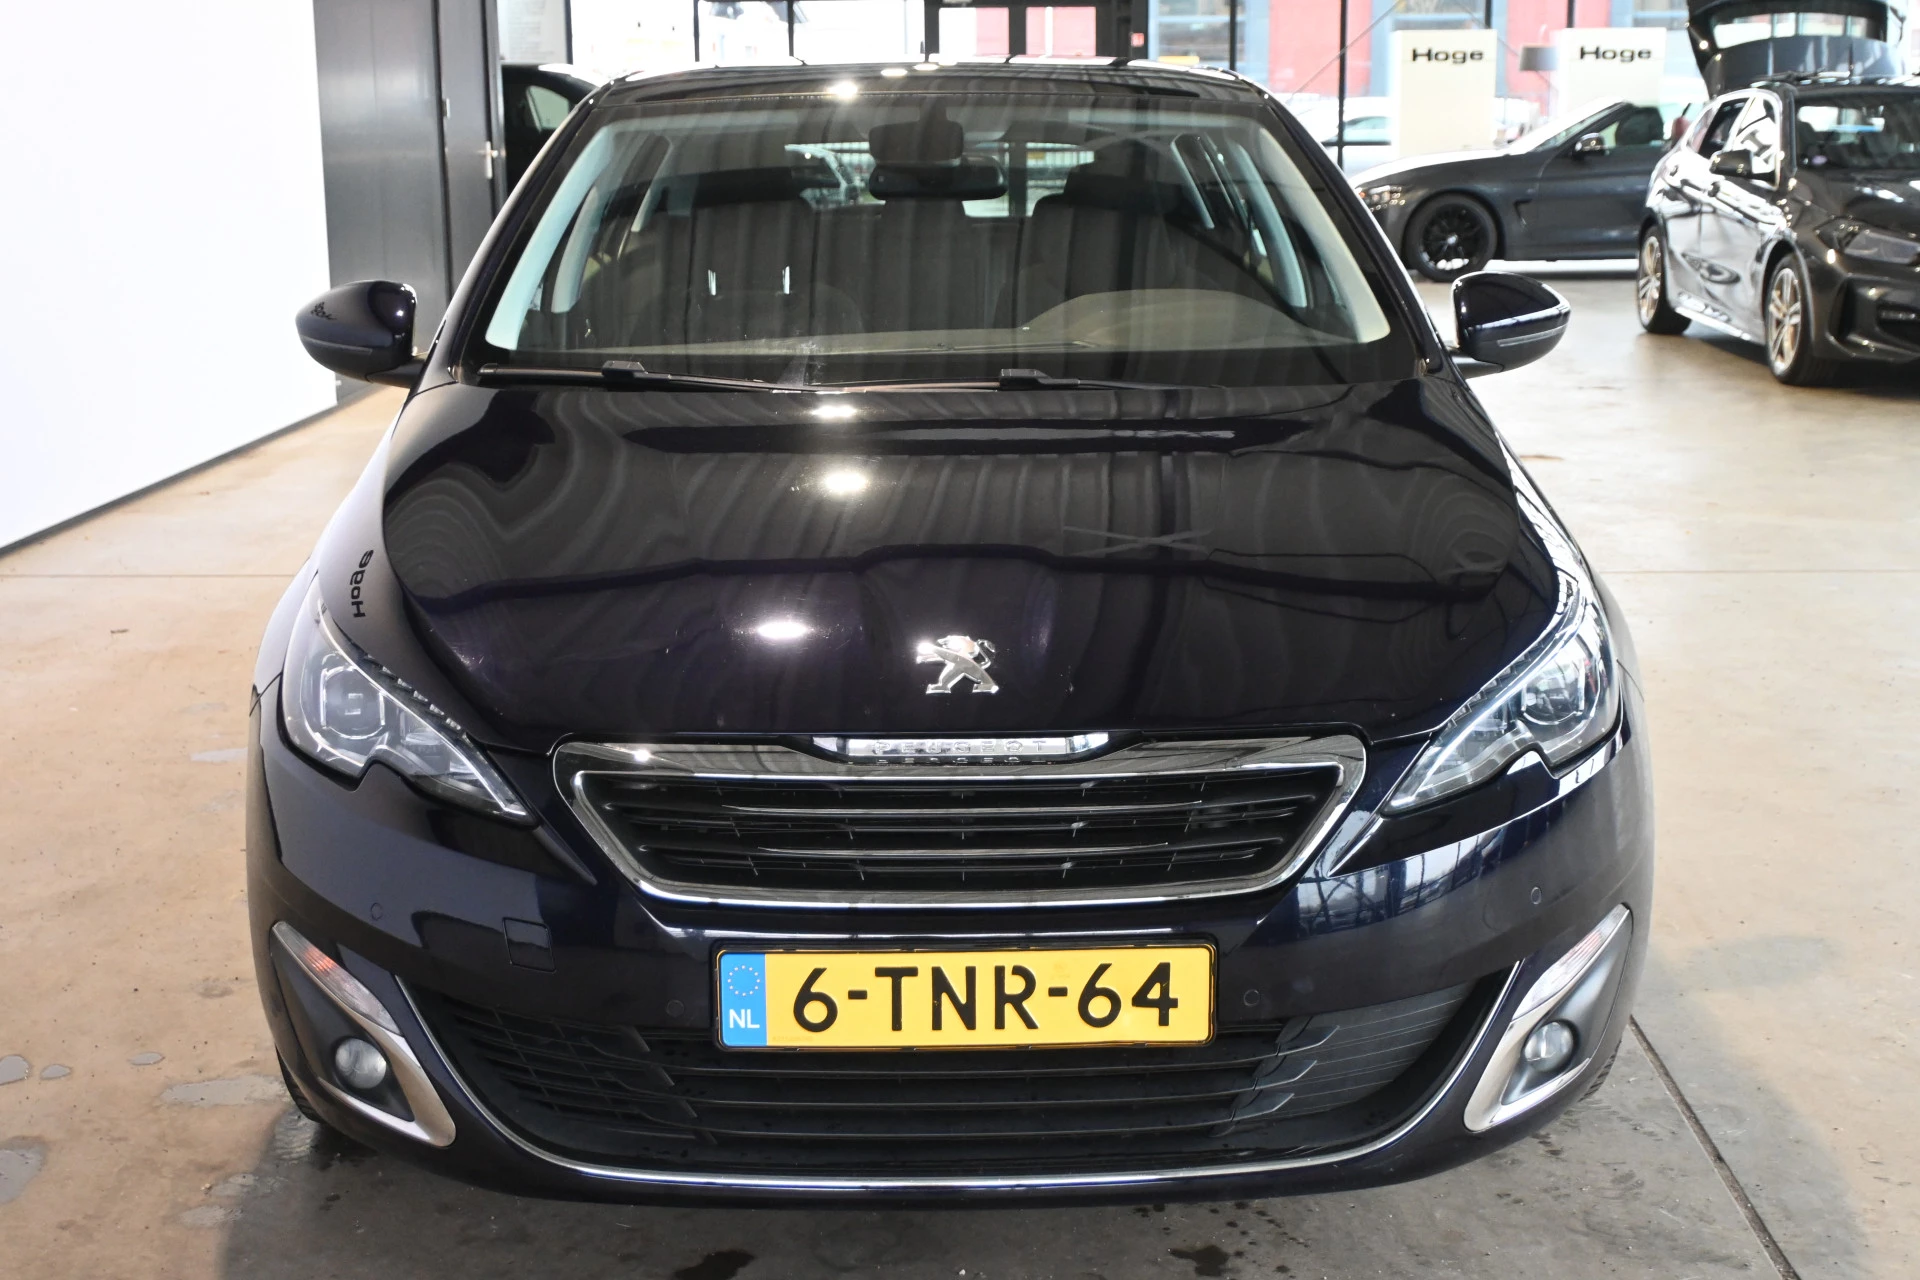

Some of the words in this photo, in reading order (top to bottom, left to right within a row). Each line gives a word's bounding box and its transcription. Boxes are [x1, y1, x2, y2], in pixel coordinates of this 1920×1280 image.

[1411, 45, 1484, 64] Hoge
[1579, 45, 1652, 63] Hoge
[873, 740, 1047, 755] PEUGEOT
[792, 961, 1179, 1034] 6-TNR-64
[728, 1008, 760, 1030] NL
